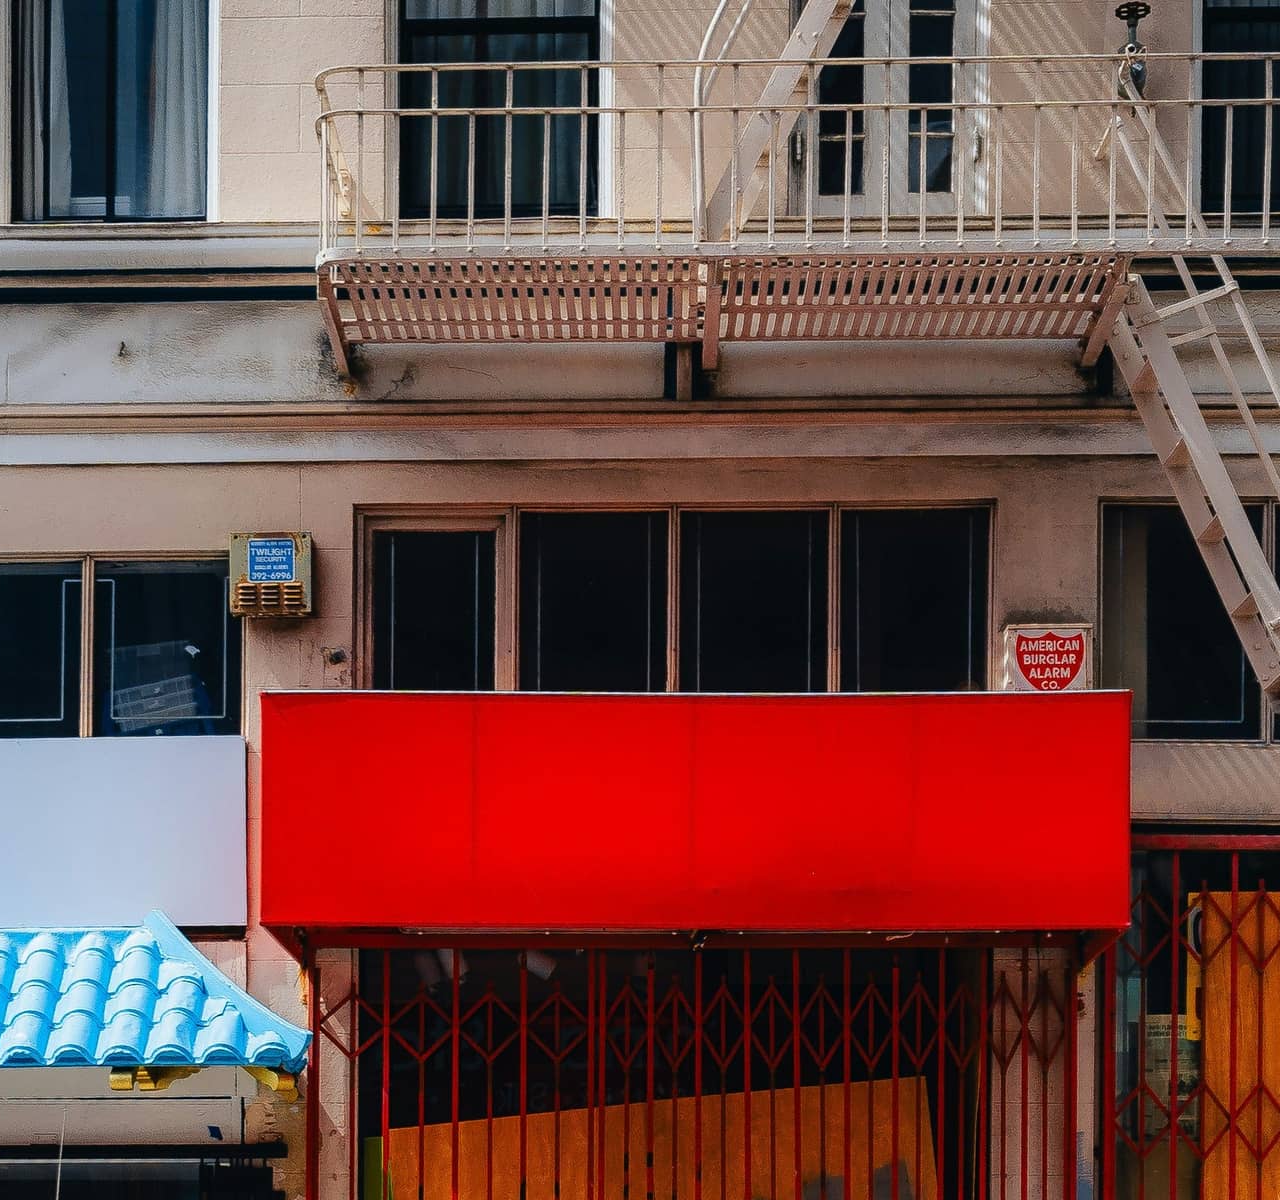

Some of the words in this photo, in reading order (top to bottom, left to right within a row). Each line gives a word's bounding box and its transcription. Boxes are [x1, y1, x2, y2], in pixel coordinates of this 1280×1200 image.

[250, 548, 292, 556] TWILIGHT
[251, 572, 292, 580] 392-6996
[1020, 640, 1080, 651] AMERICAN
[1023, 654, 1076, 665] BURGLAR
[1029, 667, 1071, 679] ALARM
[1041, 680, 1061, 690] CO.
